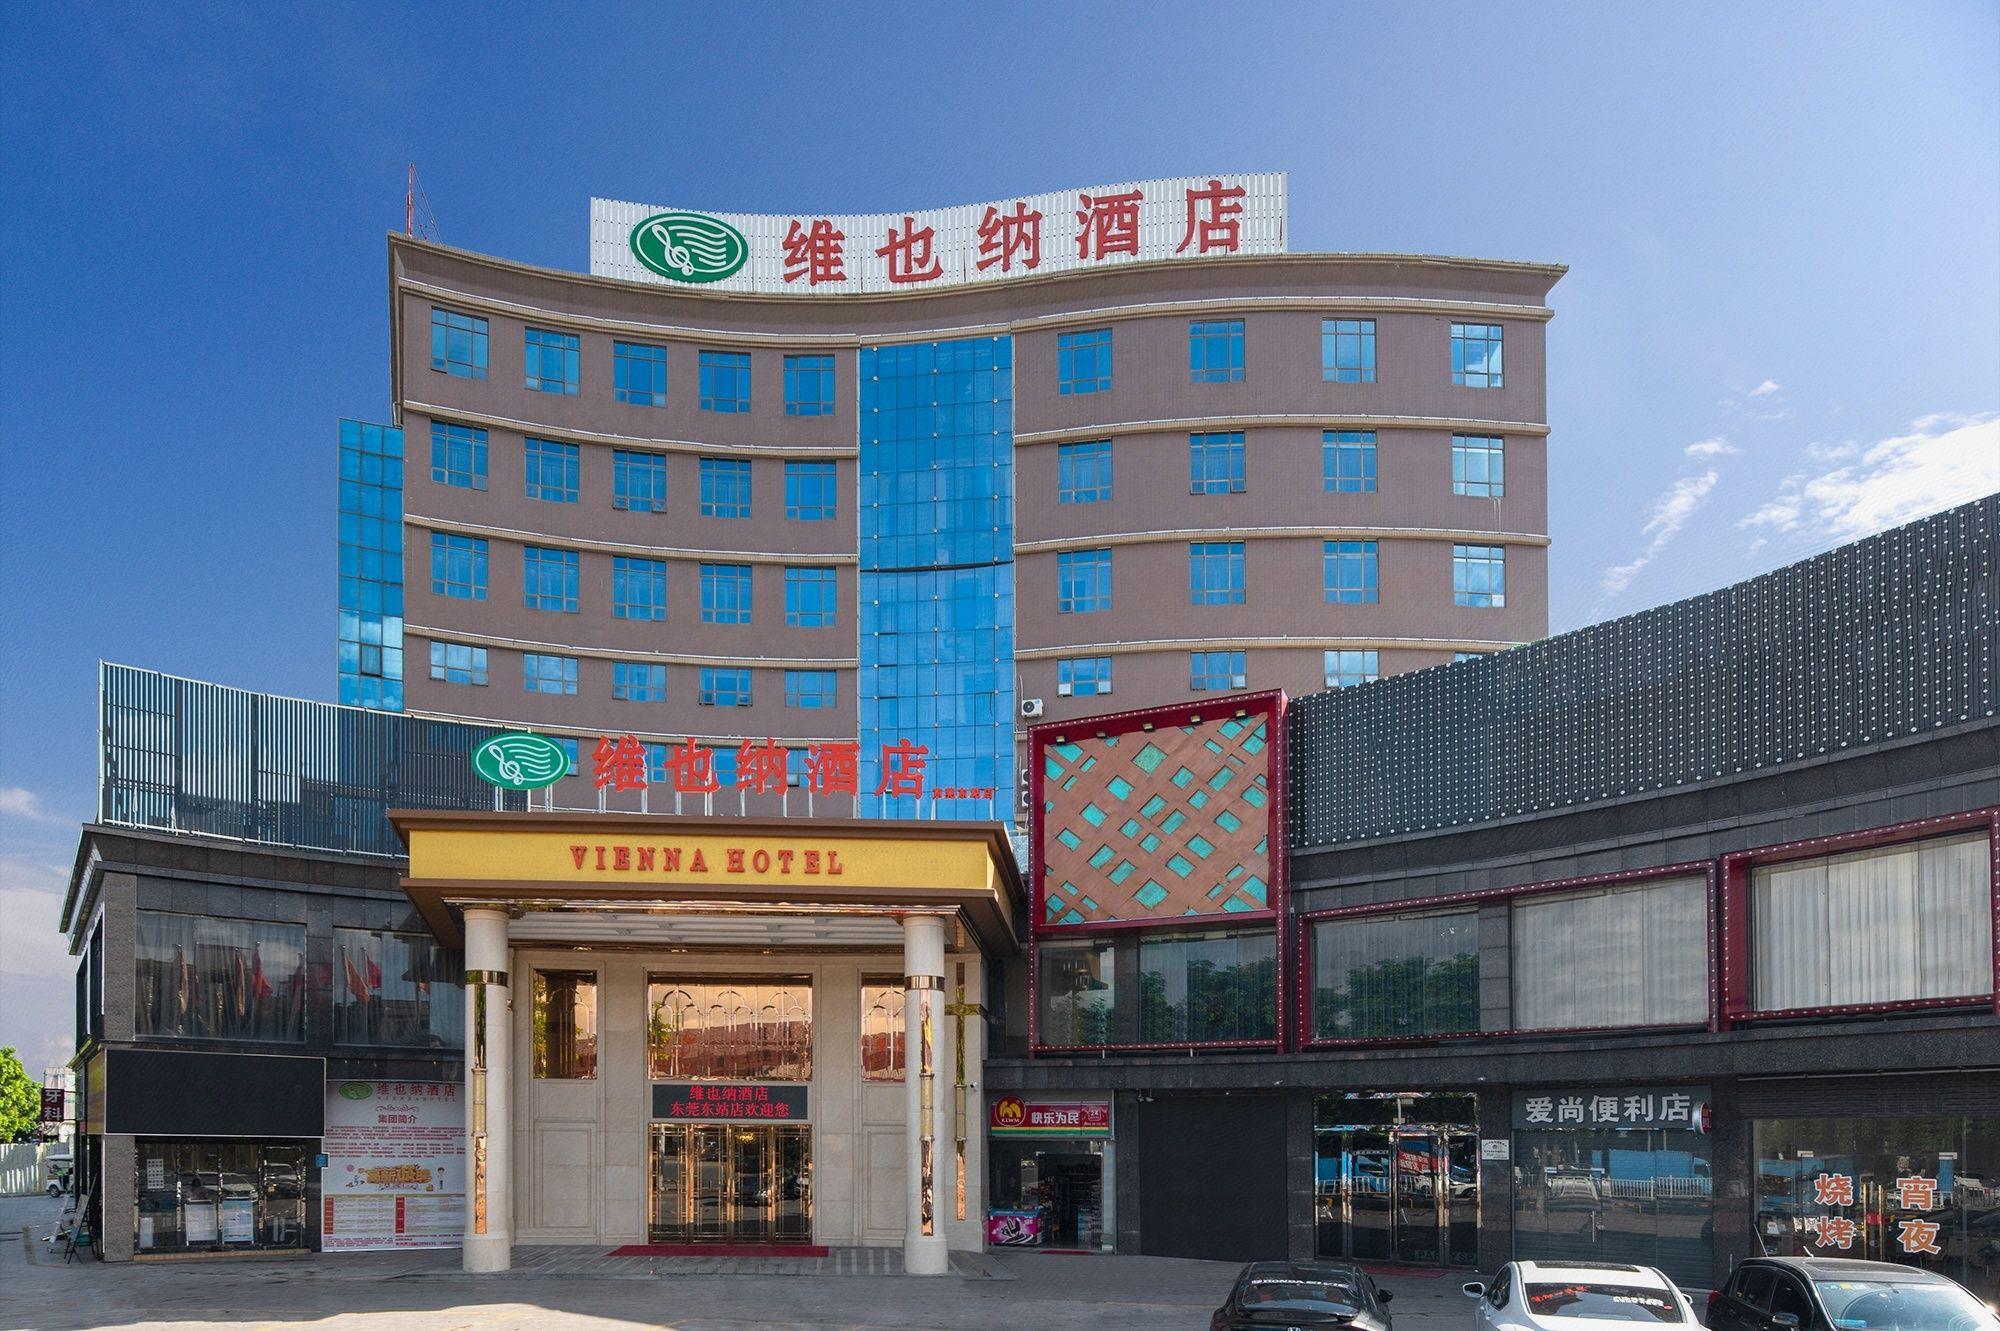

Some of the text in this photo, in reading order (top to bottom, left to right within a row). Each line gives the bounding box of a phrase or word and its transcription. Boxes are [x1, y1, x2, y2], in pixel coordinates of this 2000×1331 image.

[781, 180, 1247, 287] 维也纳酒店
[592, 735, 930, 799] 维也纳酒店
[570, 845, 843, 875] VIENNA HOTEL
[377, 1082, 456, 1096] 维也纳酒店
[689, 1084, 769, 1101] 维也纳酒店
[44, 1089, 62, 1120] 牙科
[378, 1114, 417, 1124] 集团简介
[670, 1102, 790, 1118] 东莞东站店欢迎您
[1031, 1111, 1080, 1124] 快乐为民
[1525, 1093, 1691, 1124] 爱尚便利店
[1814, 1173, 1853, 1249] 烧烤
[1896, 1176, 1941, 1255] 宵夜
